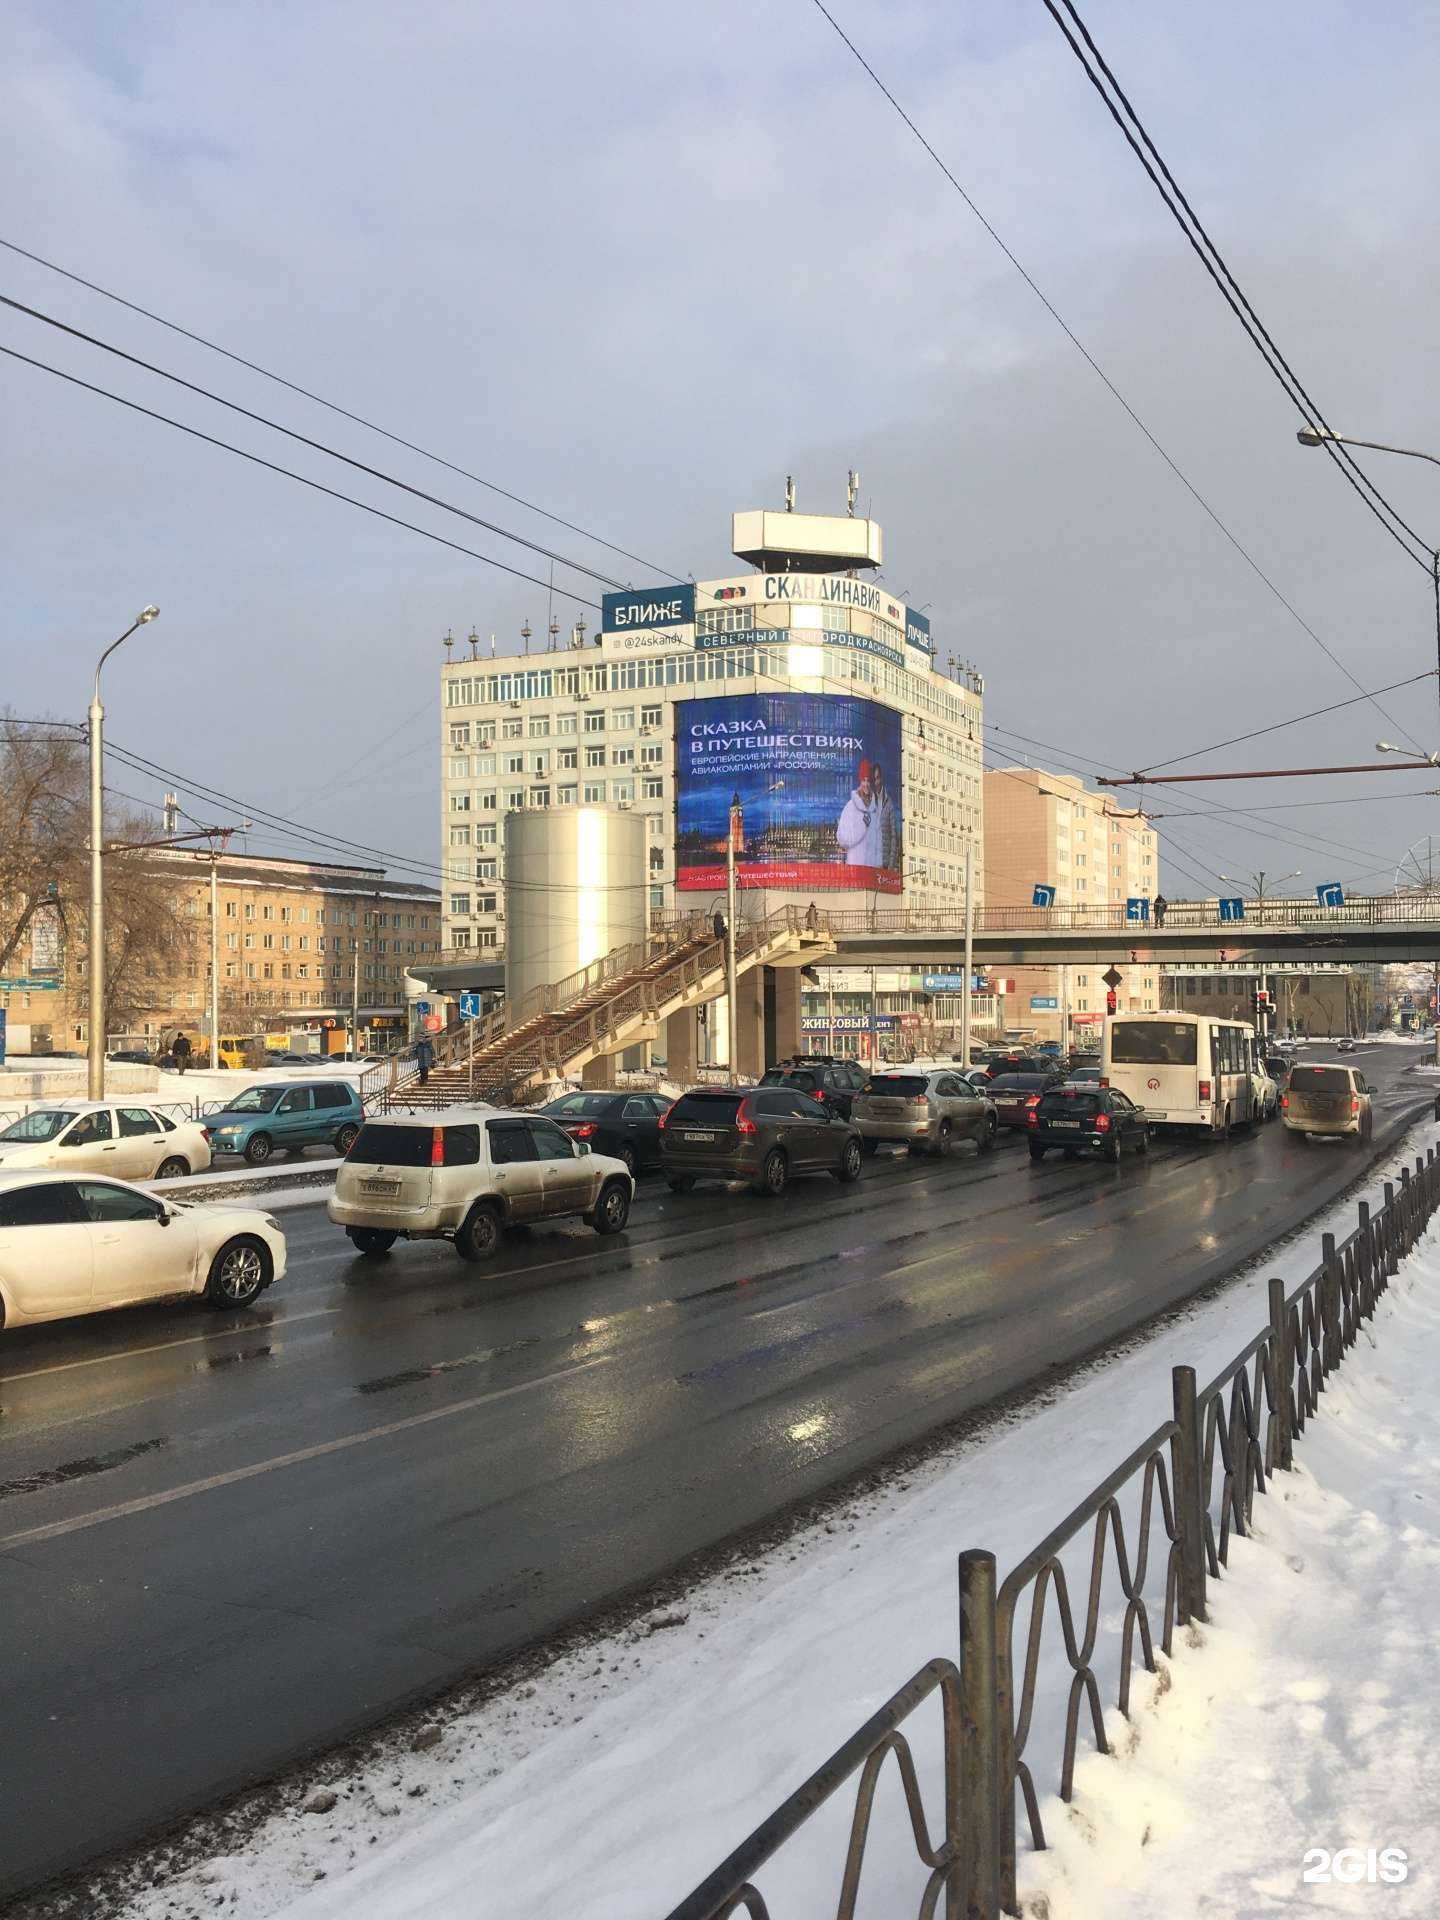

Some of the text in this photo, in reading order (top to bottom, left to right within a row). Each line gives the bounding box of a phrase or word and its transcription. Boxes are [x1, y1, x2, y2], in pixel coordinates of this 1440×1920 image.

[765, 576, 880, 613] СКАНДИНАВИЯ
[615, 600, 682, 625] БЛИЖЕ
[624, 632, 683, 649] @24skandy
[703, 630, 778, 647] СЕВЕРНЫЙ
[907, 623, 929, 649] ЛУЧШЕ
[691, 719, 767, 736] СКАЗКА
[691, 734, 863, 753] В ПУТЕШЕСТВИЯХ
[691, 751, 837, 765] ЕВРОПЕЙСКИЕ НАПРАВЛЕНИЯ
[691, 762, 771, 775] АВИАКОМПАНИИ
